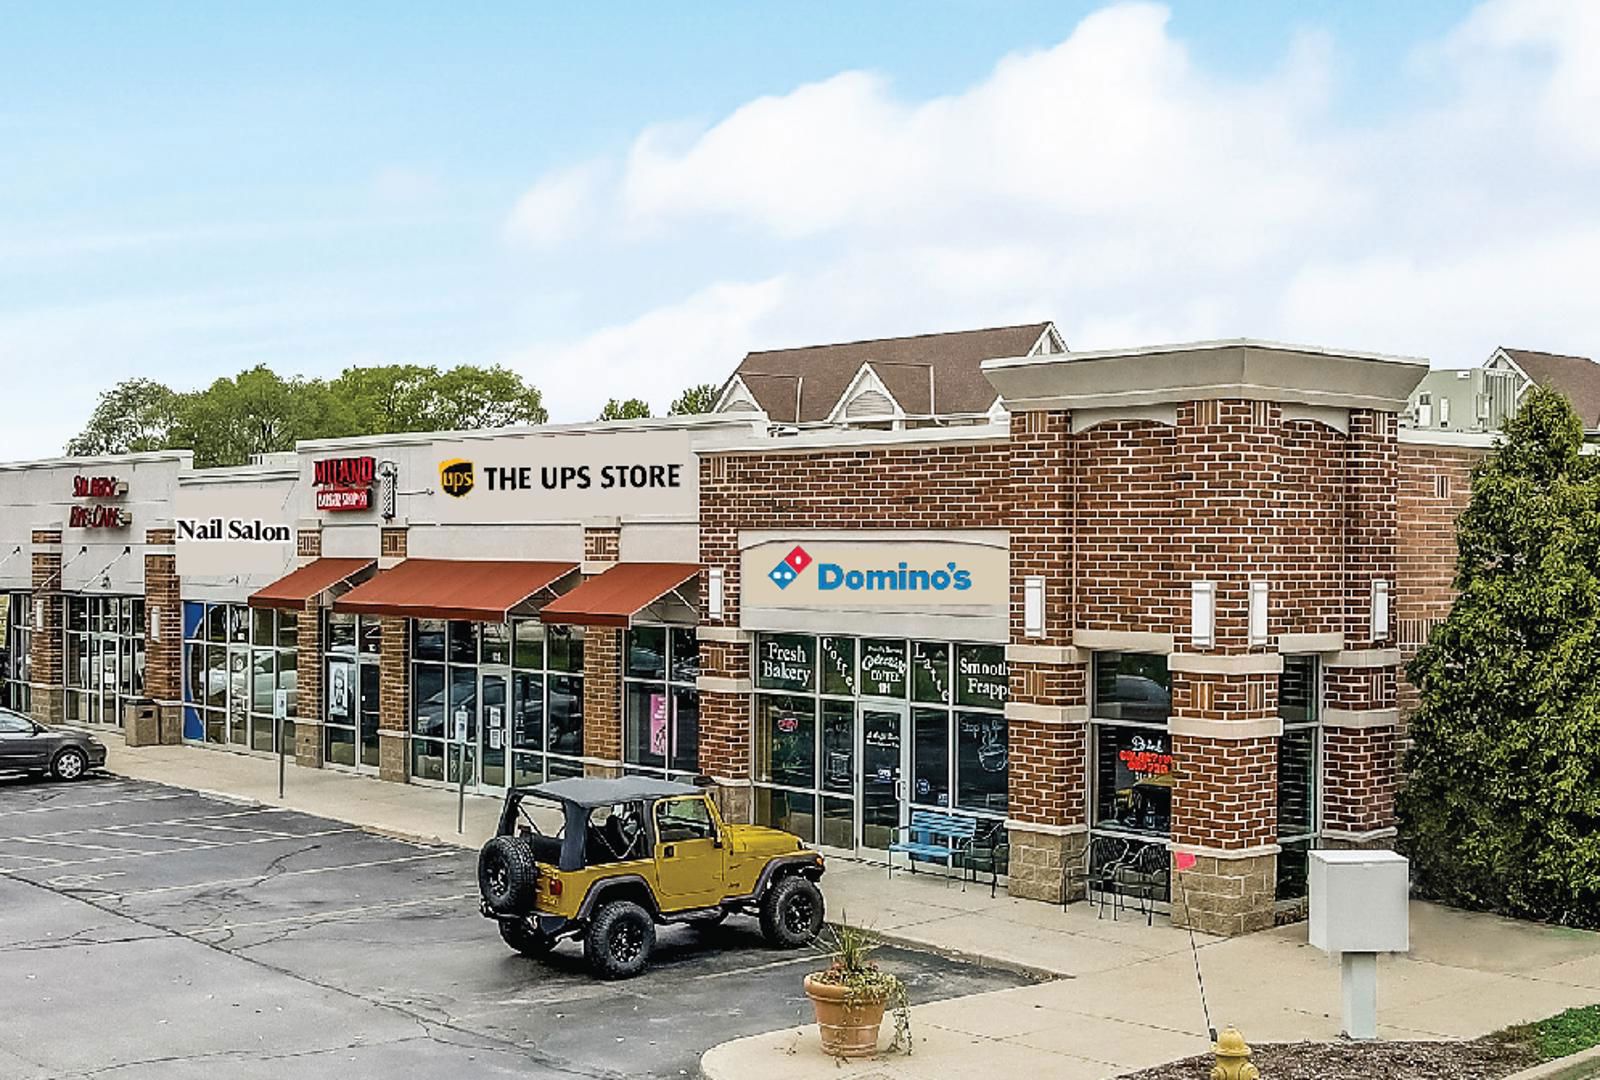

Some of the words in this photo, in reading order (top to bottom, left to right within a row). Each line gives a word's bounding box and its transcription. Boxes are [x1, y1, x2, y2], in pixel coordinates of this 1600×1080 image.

[312, 456, 375, 486] MILANO
[443, 471, 473, 492] ups
[483, 467, 531, 491] THE
[541, 466, 591, 489] UPS
[600, 464, 682, 489] STORE
[176, 519, 222, 540] Nail
[228, 520, 290, 541] Salon
[818, 562, 972, 591] Domino's
[767, 642, 806, 663] Fresh
[762, 660, 811, 687] Bakery
[967, 678, 1010, 700] Frapp
